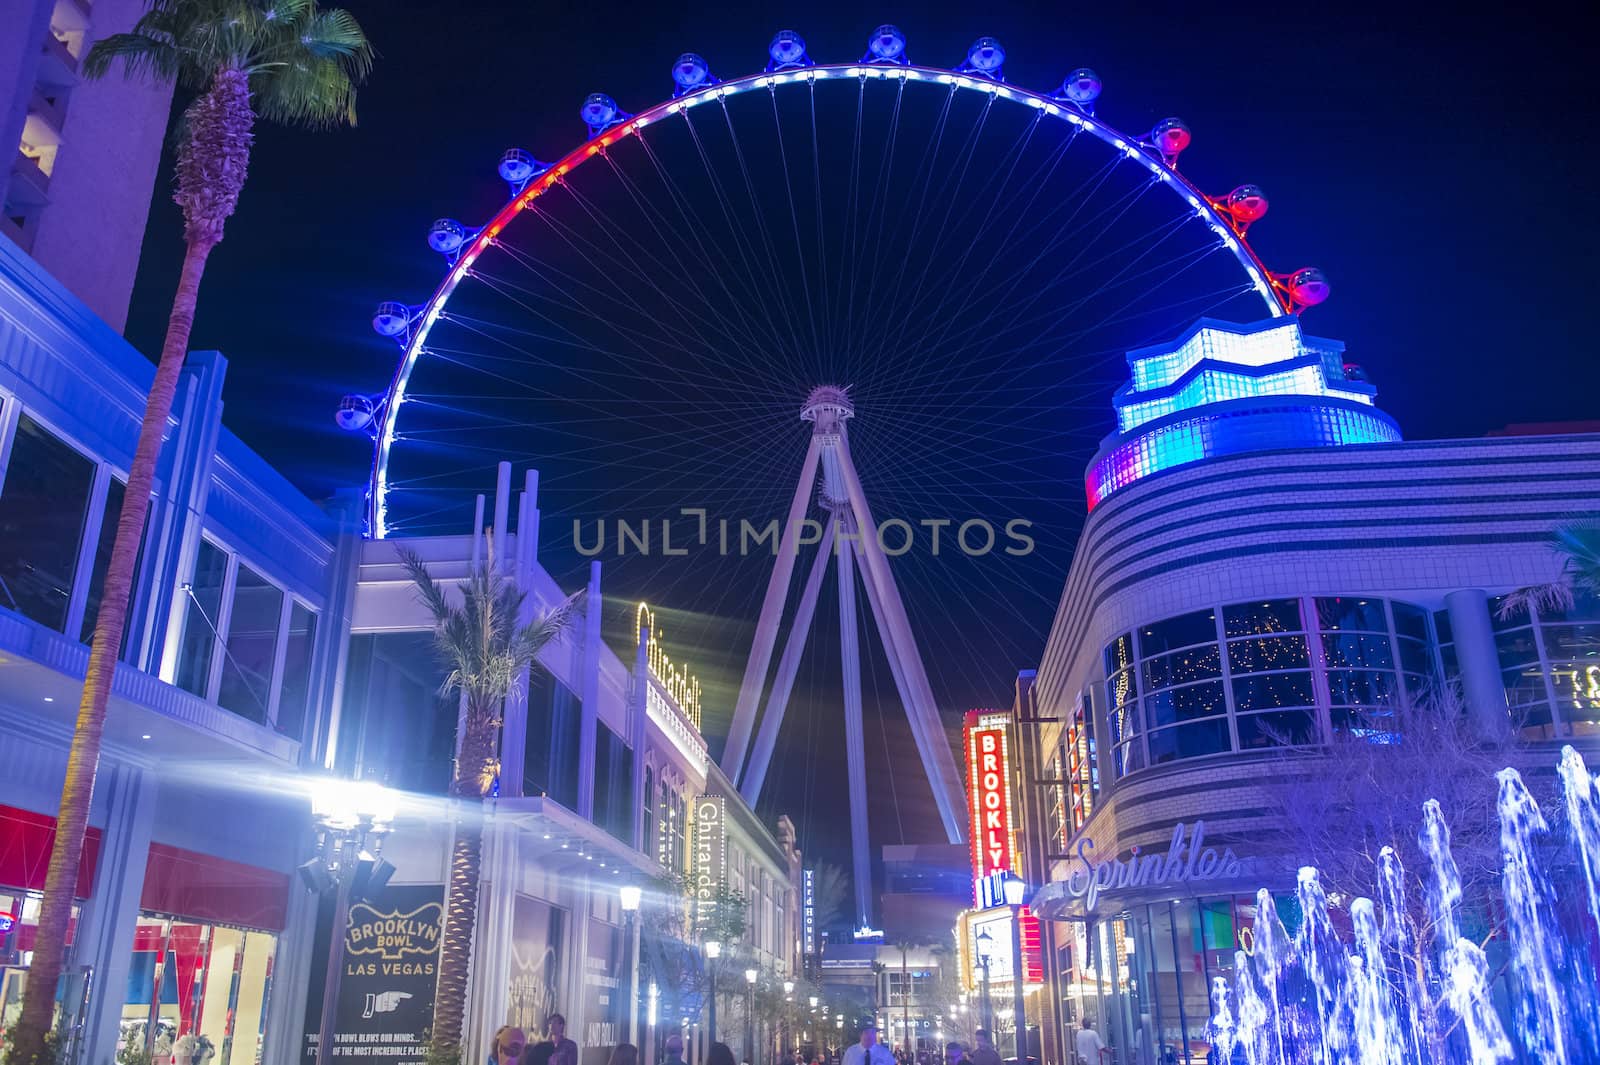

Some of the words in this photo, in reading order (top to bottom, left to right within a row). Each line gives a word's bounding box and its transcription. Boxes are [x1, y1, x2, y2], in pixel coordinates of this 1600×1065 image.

[698, 802, 719, 922] Ghirardelli
[1068, 820, 1244, 911] Sprinkles
[350, 919, 439, 943] BROOKLYN
[377, 935, 413, 947] BOWL
[347, 963, 377, 976] LAS
[382, 963, 434, 976] VEGAS
[340, 1033, 358, 1043] BOWL
[358, 1033, 379, 1043] BLOWS
[380, 1033, 393, 1043] OUR
[332, 1046, 341, 1056] OF
[341, 1046, 353, 1056] THE
[353, 1046, 371, 1056] MOST
[372, 1046, 408, 1056] INCREDIBLE
